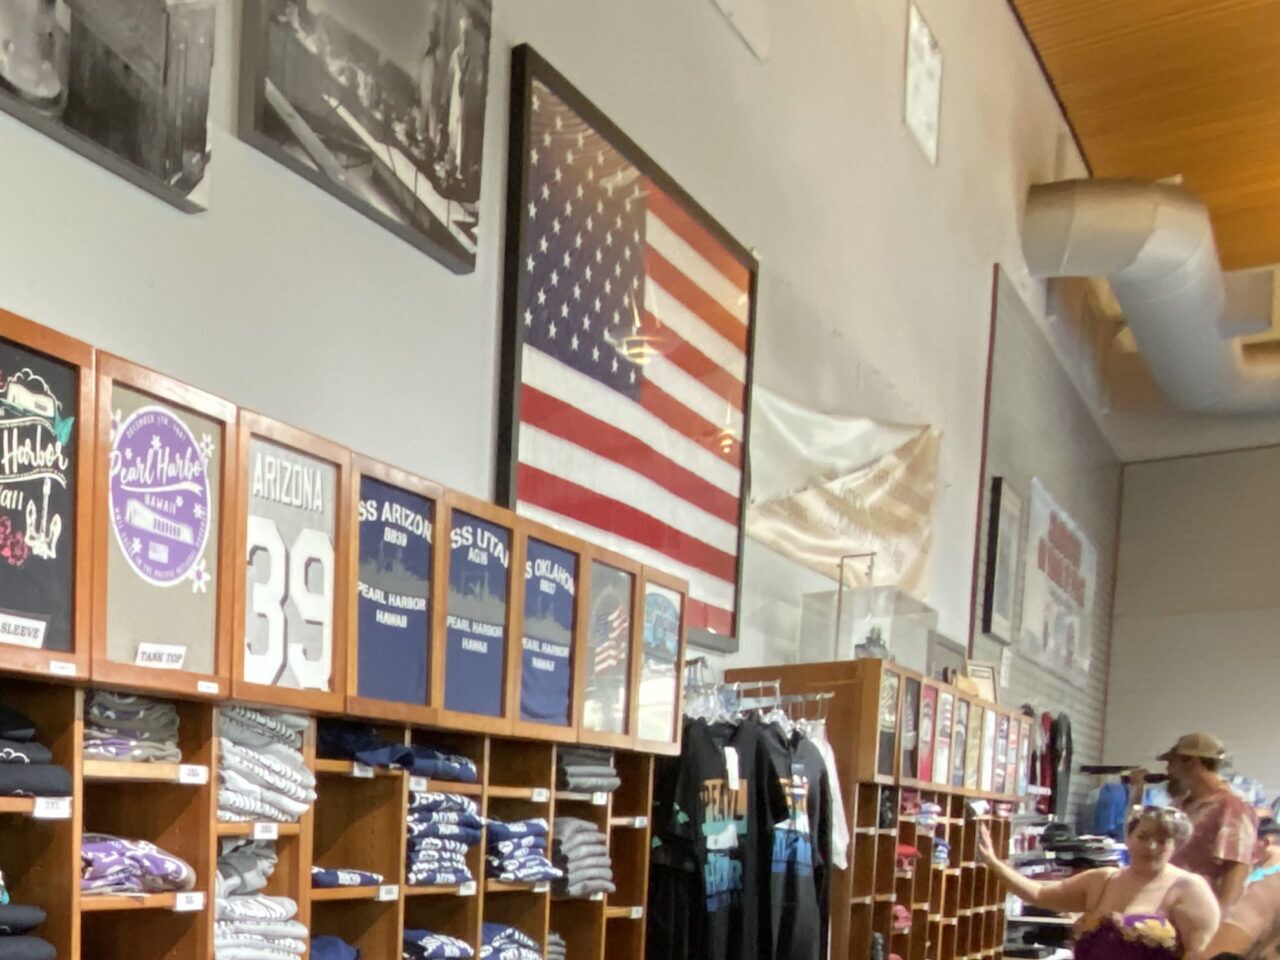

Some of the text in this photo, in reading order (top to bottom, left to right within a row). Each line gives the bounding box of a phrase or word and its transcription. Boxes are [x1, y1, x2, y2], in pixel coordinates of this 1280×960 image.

[1, 424, 68, 475] Harbor
[109, 446, 155, 486] Pearl
[253, 452, 324, 513] ARIZONA
[244, 515, 336, 691] 39
[358, 581, 426, 611] PEARL HARBOR
[0, 620, 40, 639] SLEEVE
[376, 609, 408, 628] HAWAII
[446, 615, 503, 638] PEARL HARBOR
[461, 637, 488, 654] HAWAII
